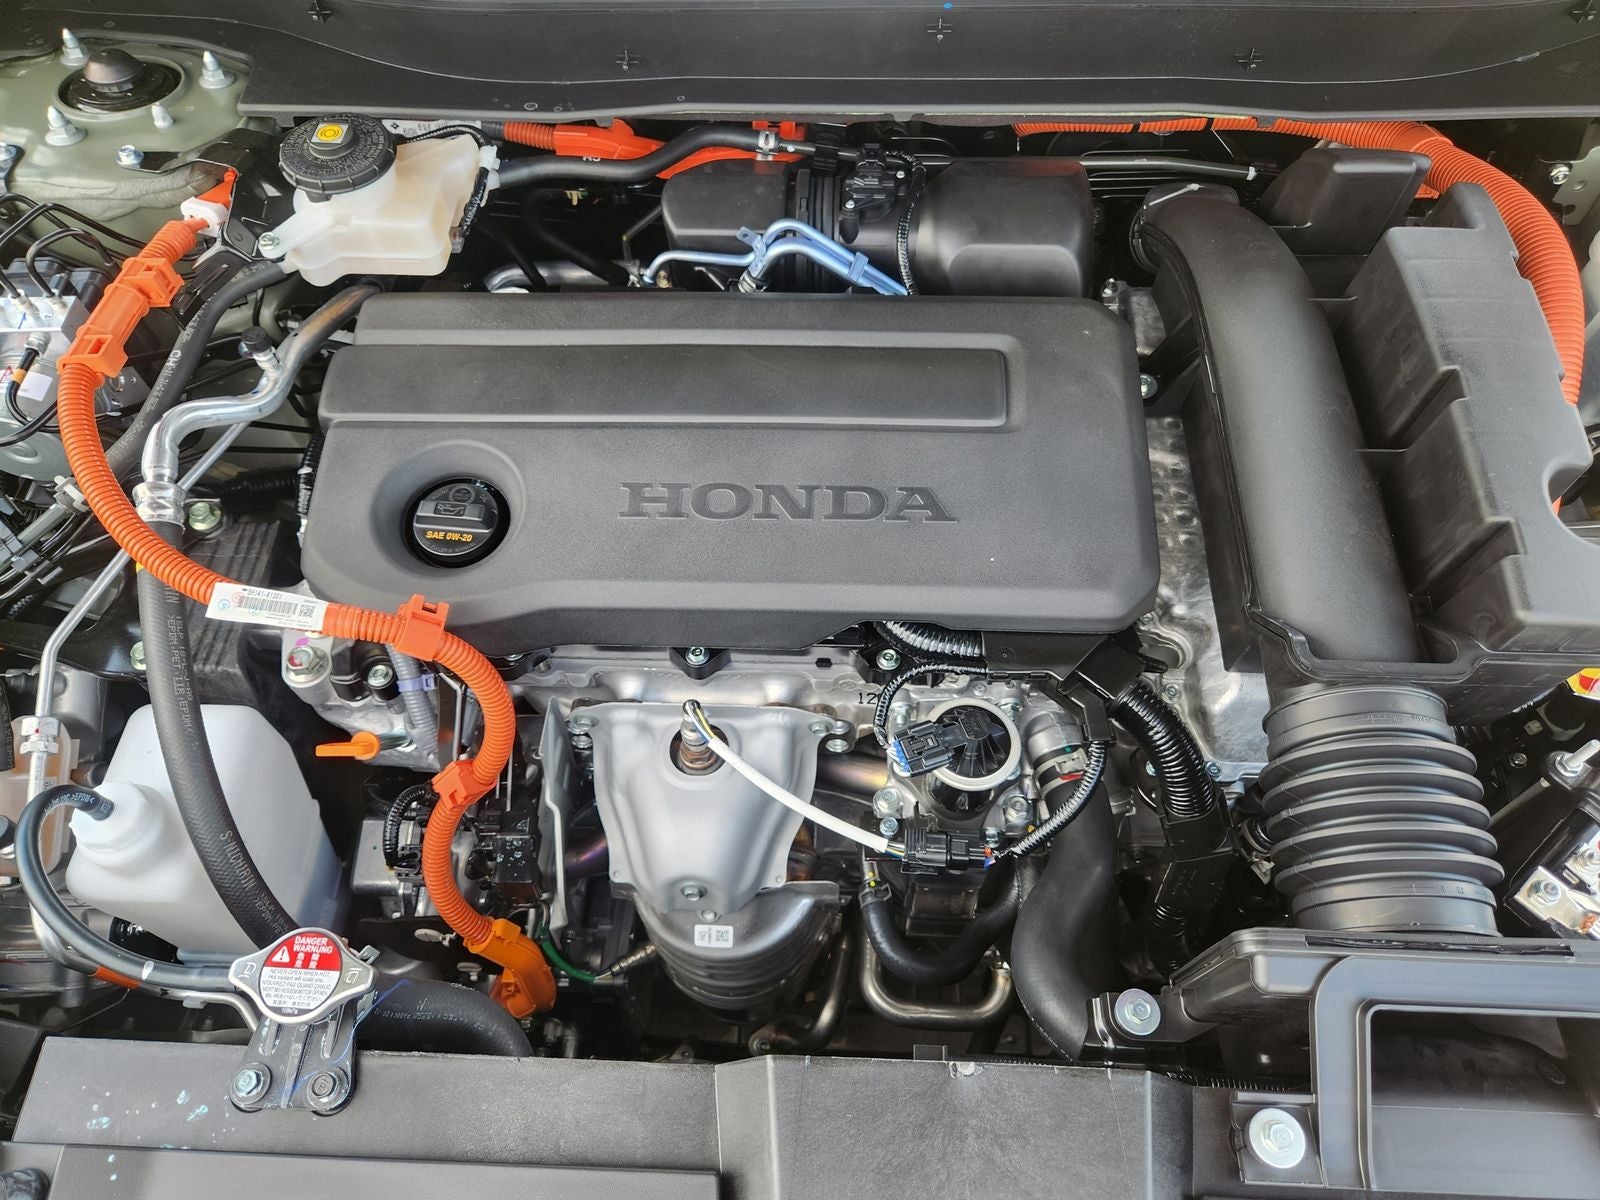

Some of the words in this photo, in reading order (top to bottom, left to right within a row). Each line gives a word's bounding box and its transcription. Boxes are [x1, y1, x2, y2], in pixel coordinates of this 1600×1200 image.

[617, 482, 959, 523] HONDA
[425, 531, 445, 540] SAE
[446, 532, 473, 542] 0W-20
[295, 936, 329, 946] DANGER
[293, 944, 333, 954] WARNUNG
